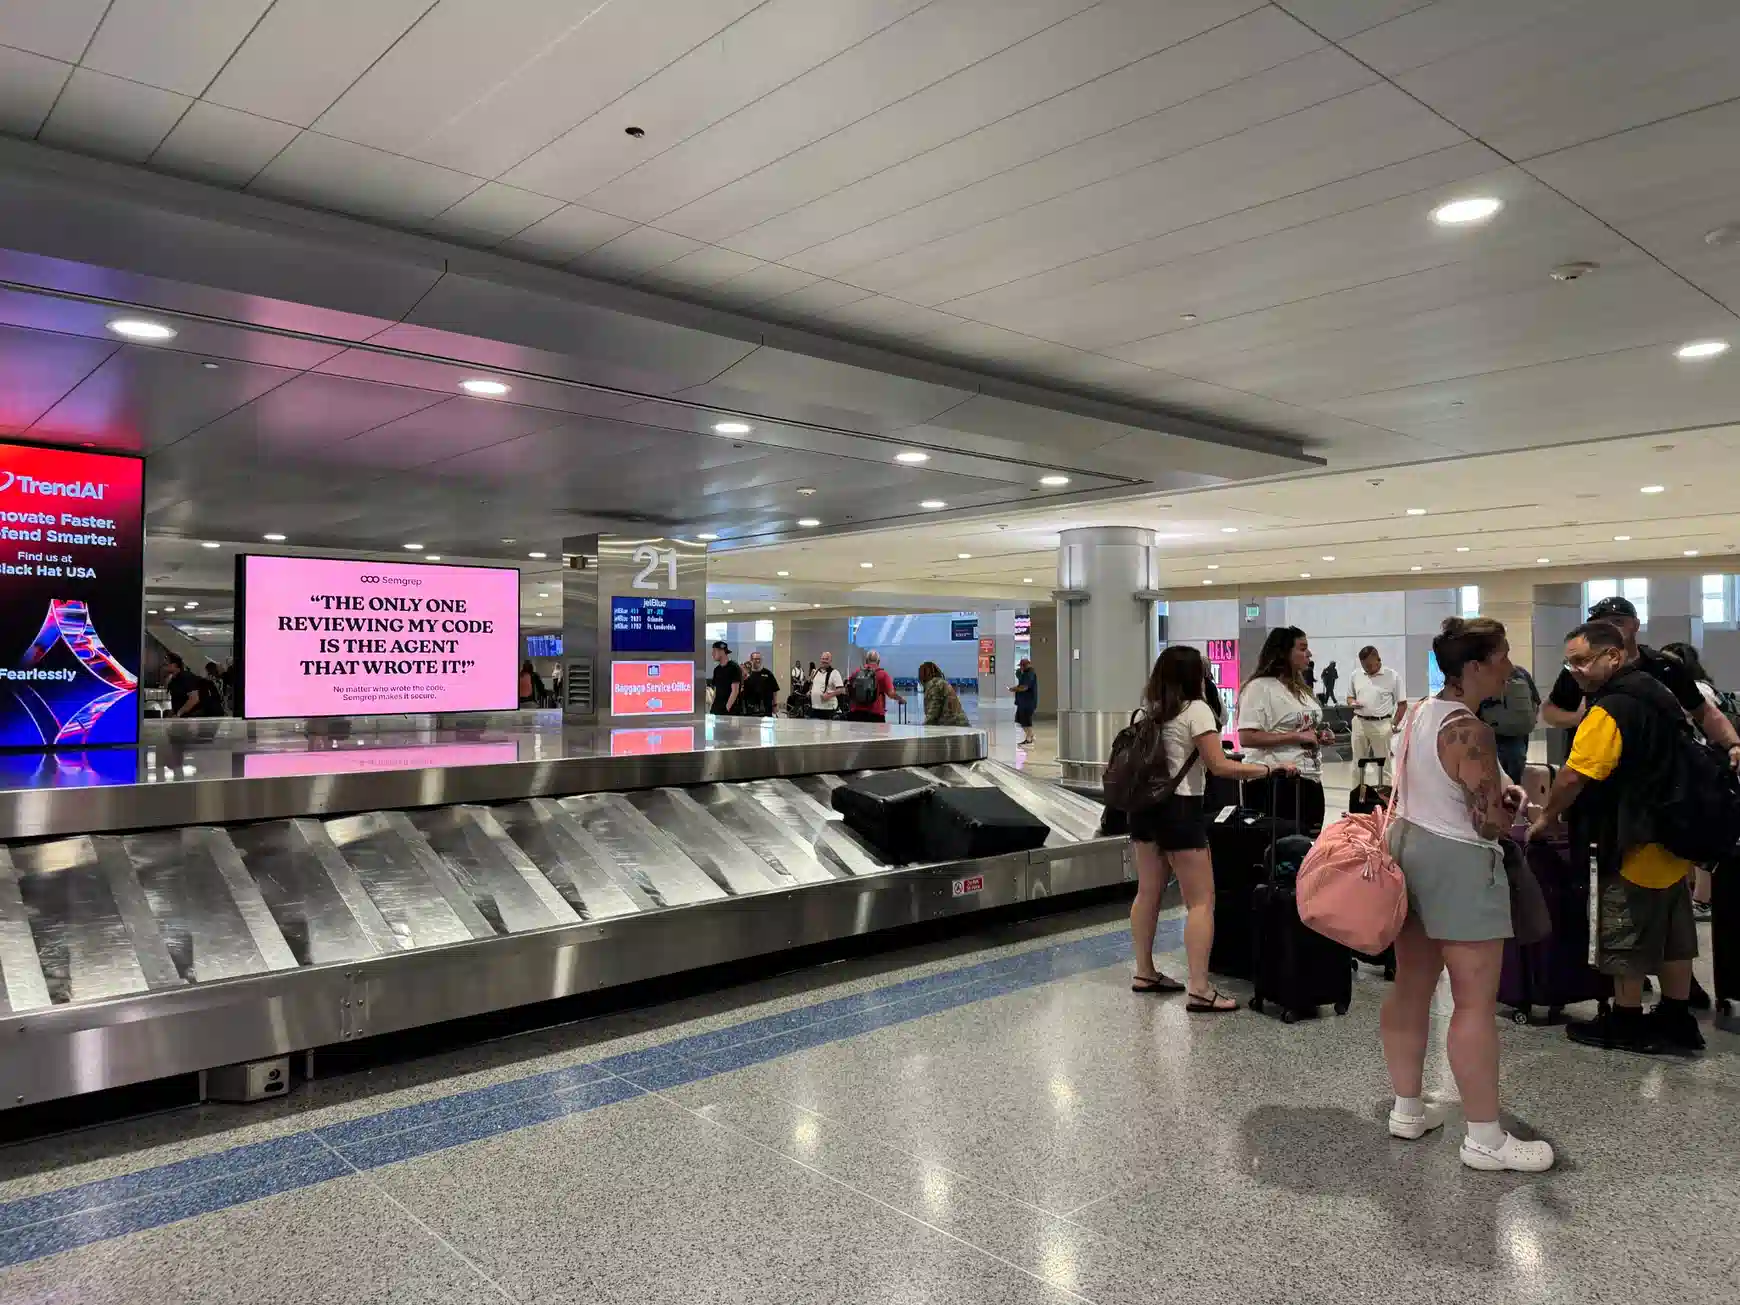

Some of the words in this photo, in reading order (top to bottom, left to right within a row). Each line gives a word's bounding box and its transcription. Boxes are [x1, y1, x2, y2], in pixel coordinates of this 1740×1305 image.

[61, 512, 117, 530] Faster.
[0, 527, 41, 541] fend
[46, 530, 118, 547] Smarter.
[18, 551, 43, 562] Find
[46, 554, 58, 562] us
[61, 554, 72, 563] at
[36, 565, 62, 577] Hat
[66, 566, 97, 579] USA
[632, 544, 677, 590] 21
[382, 576, 422, 587] Semgrep
[310, 595, 365, 611] “THE
[369, 596, 423, 613] ONLY
[426, 598, 467, 613] ONE
[643, 598, 667, 609] jetBlue
[278, 616, 404, 633] REVIEWING
[408, 619, 439, 633] MY
[442, 619, 494, 634] CODE
[319, 639, 340, 653] IS
[343, 639, 387, 653] THE
[390, 640, 459, 654] AGENT
[0, 667, 77, 682] Fearlessly
[300, 660, 360, 675] THAT
[362, 660, 438, 675] WROTE
[441, 660, 475, 674] IT!”
[614, 683, 646, 696] Baggage
[646, 681, 671, 693] Service
[671, 681, 691, 692] Office
[343, 693, 377, 702] Semgrep
[378, 693, 403, 701] makes
